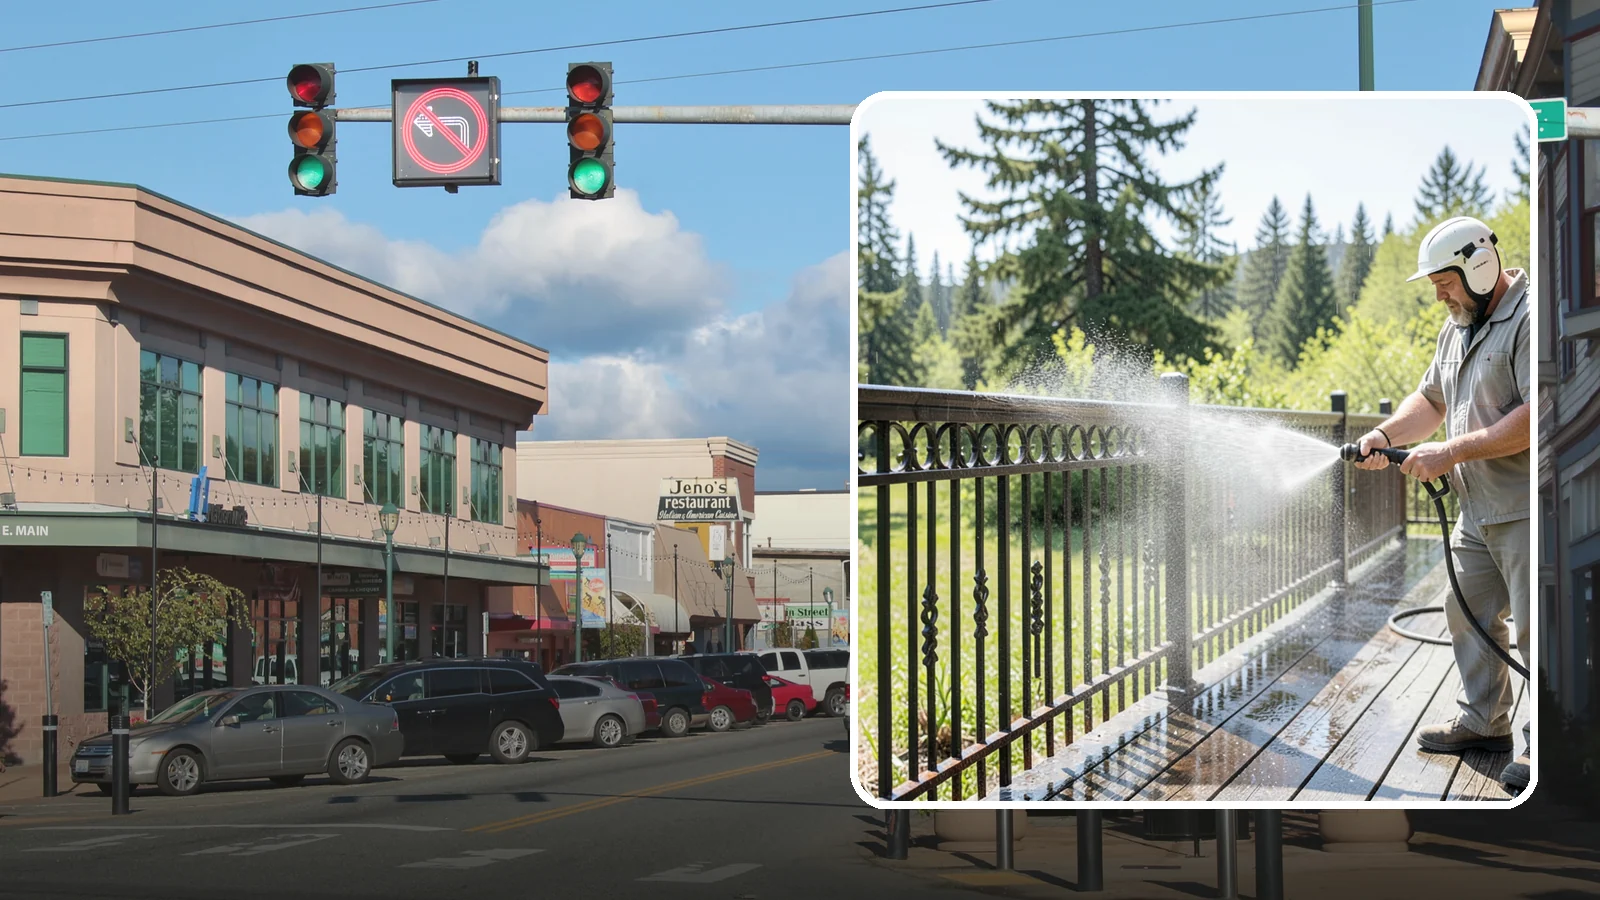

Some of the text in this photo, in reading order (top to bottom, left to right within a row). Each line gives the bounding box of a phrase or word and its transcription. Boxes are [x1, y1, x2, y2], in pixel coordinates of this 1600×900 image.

[669, 480, 727, 494] Jeno's
[665, 497, 731, 508] restaurant
[659, 510, 681, 519] Italian
[686, 509, 715, 519] American
[715, 510, 737, 519] Cuisine
[2, 525, 49, 536] E. MAIN
[797, 607, 828, 616] Street
